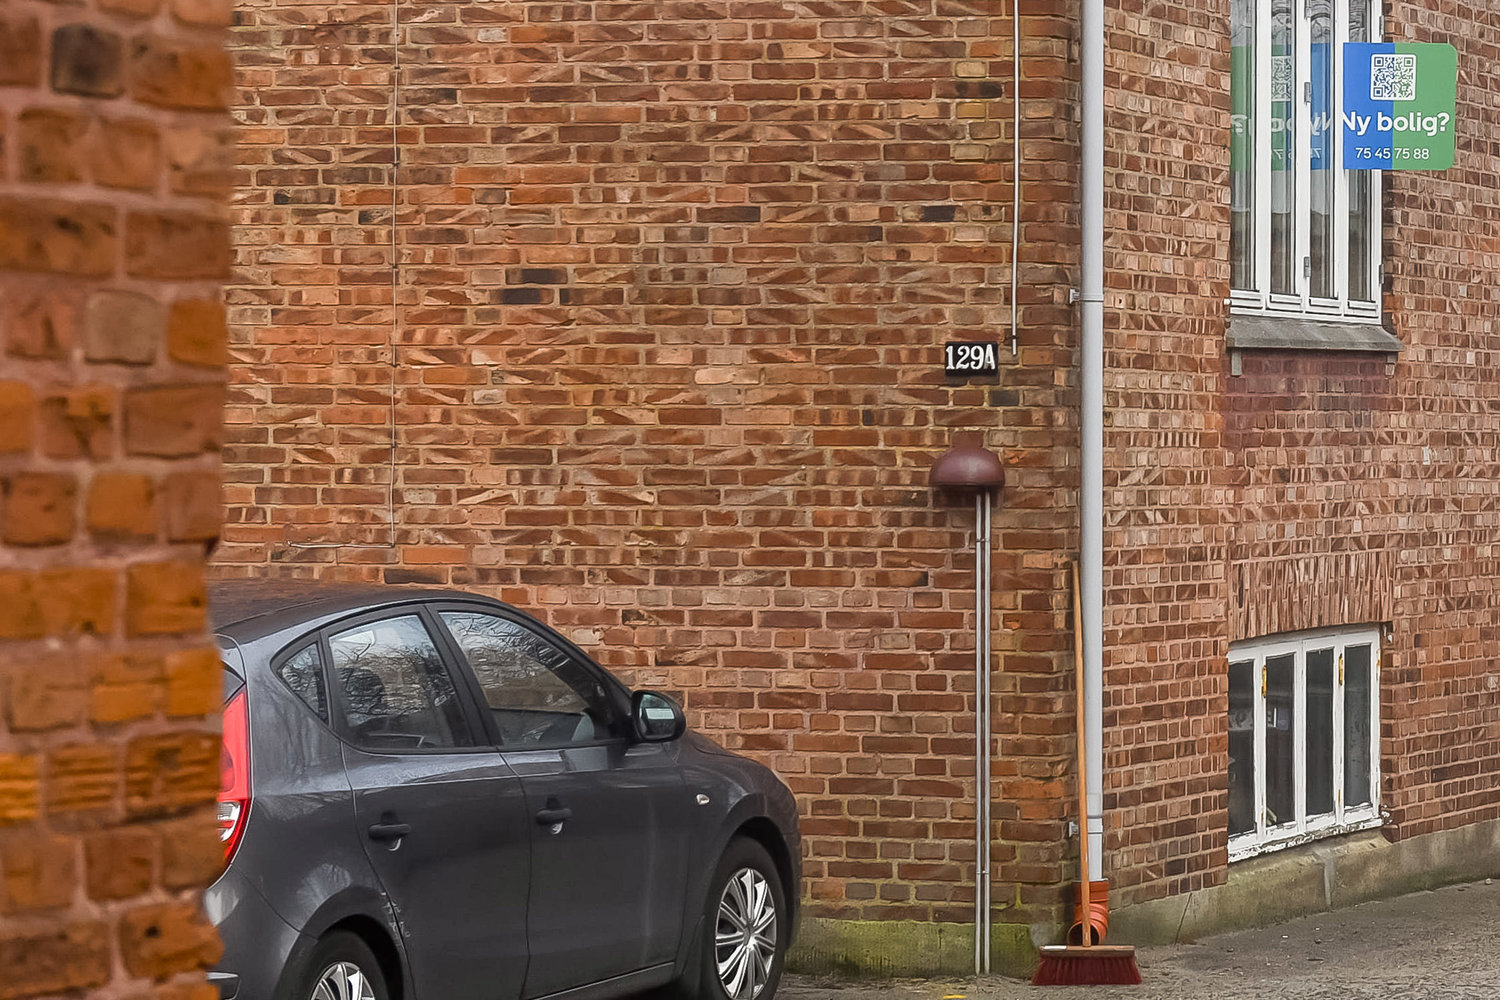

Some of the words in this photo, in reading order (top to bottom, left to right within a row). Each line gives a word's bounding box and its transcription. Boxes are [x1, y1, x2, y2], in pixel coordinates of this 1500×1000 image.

[1342, 111, 1372, 136] Ny
[1377, 111, 1450, 137] bolig?
[1355, 147, 1372, 159] 75
[1374, 147, 1391, 160] 45
[1394, 148, 1410, 160] 75
[1413, 148, 1430, 160] 88
[945, 344, 996, 370] 129A
